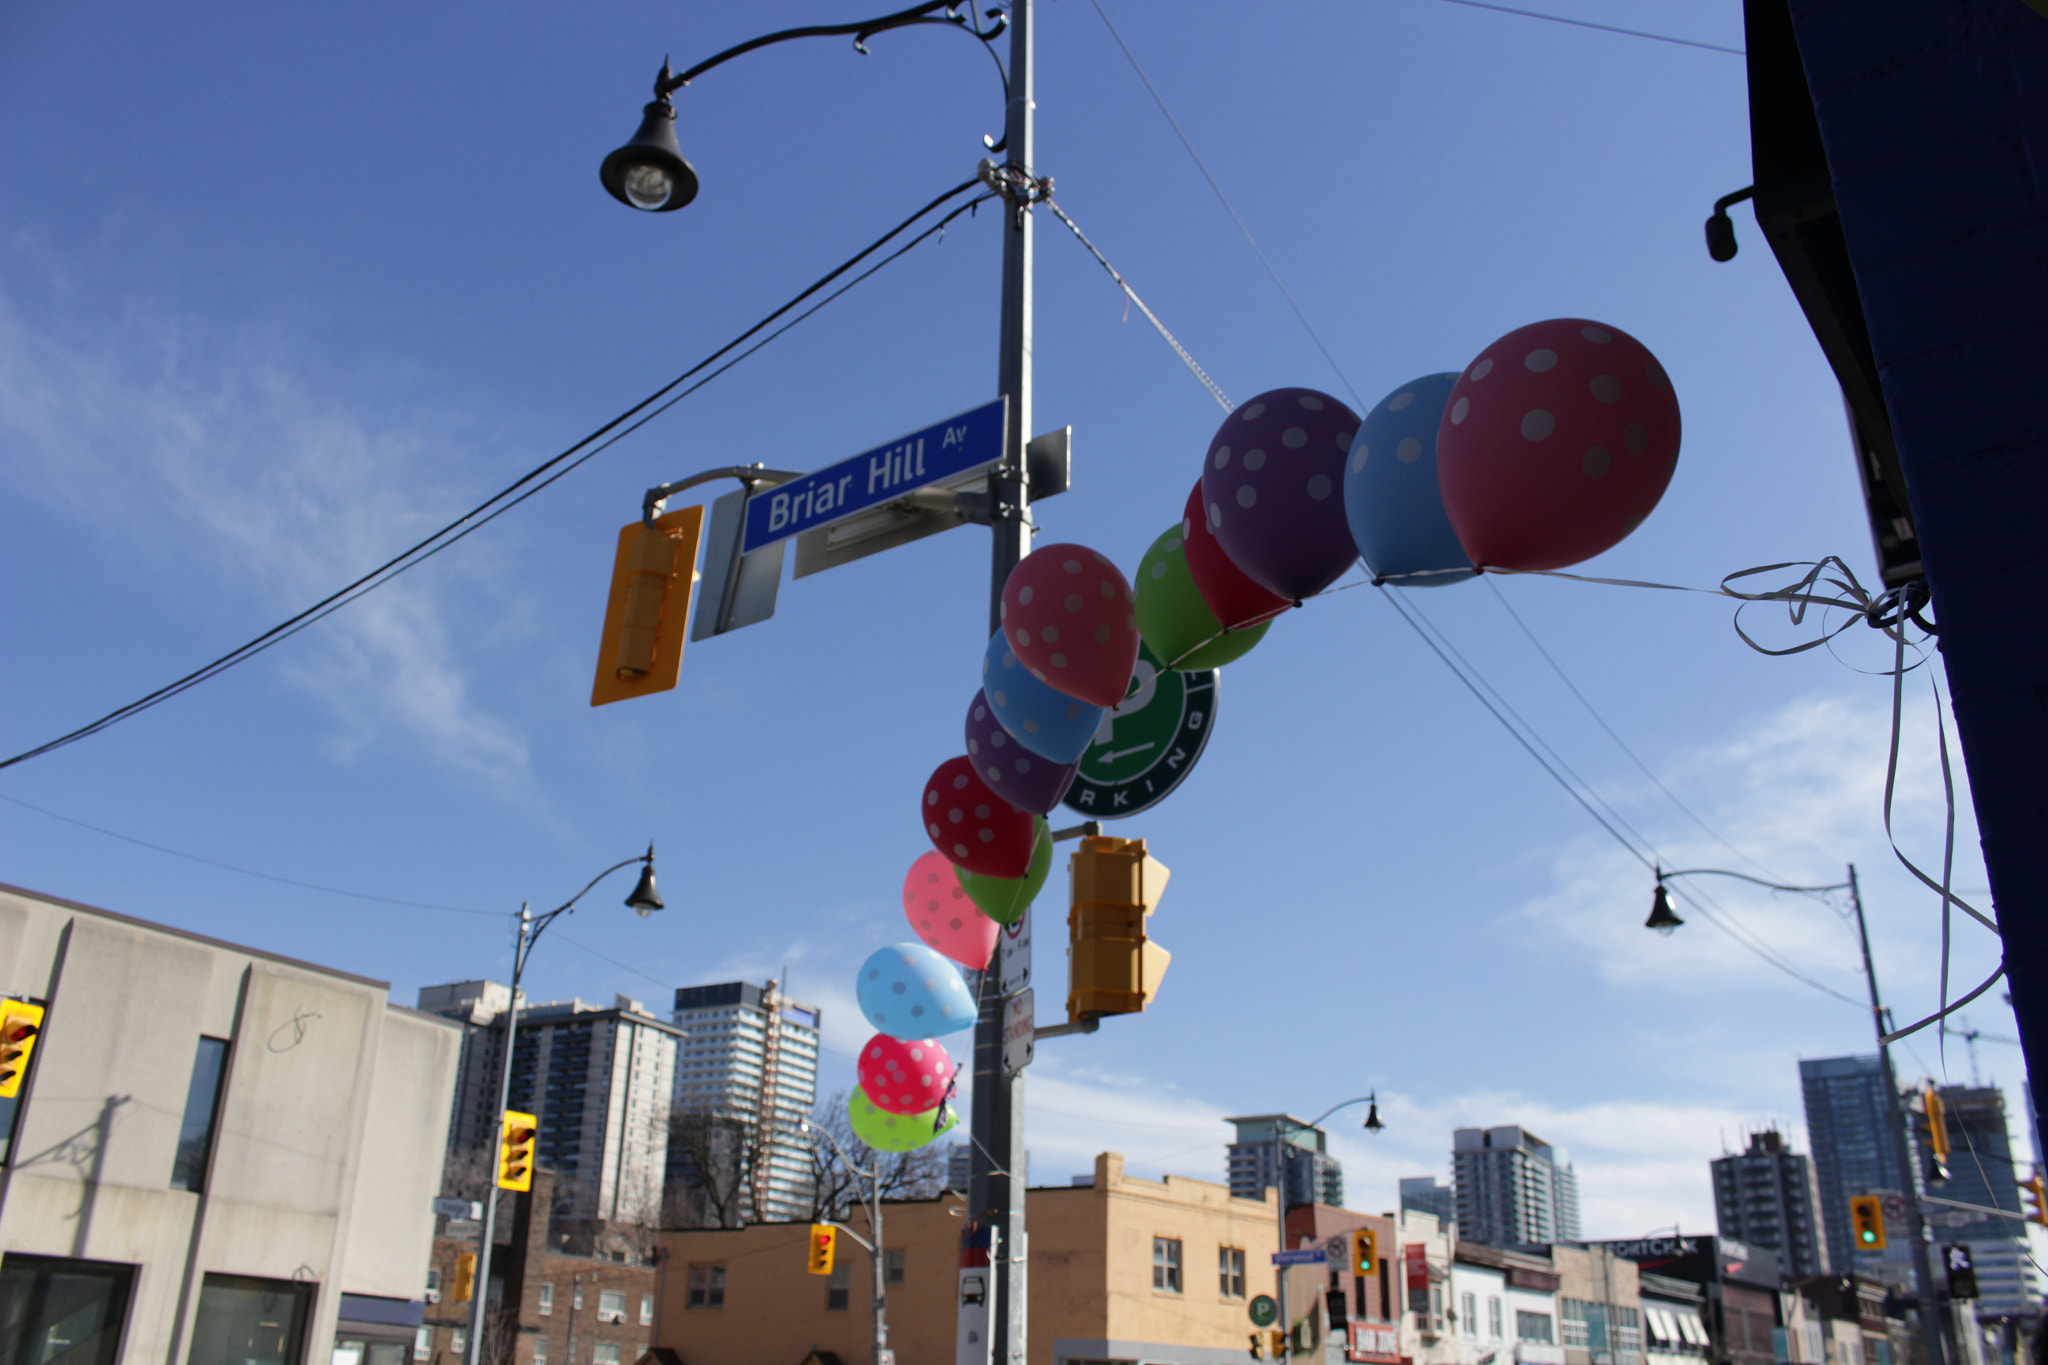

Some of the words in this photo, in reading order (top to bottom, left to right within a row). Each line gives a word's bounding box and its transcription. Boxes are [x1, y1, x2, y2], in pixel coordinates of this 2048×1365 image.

[768, 474, 852, 533] Briar
[867, 438, 925, 495] Hill
[1012, 998, 1022, 1016] NO
